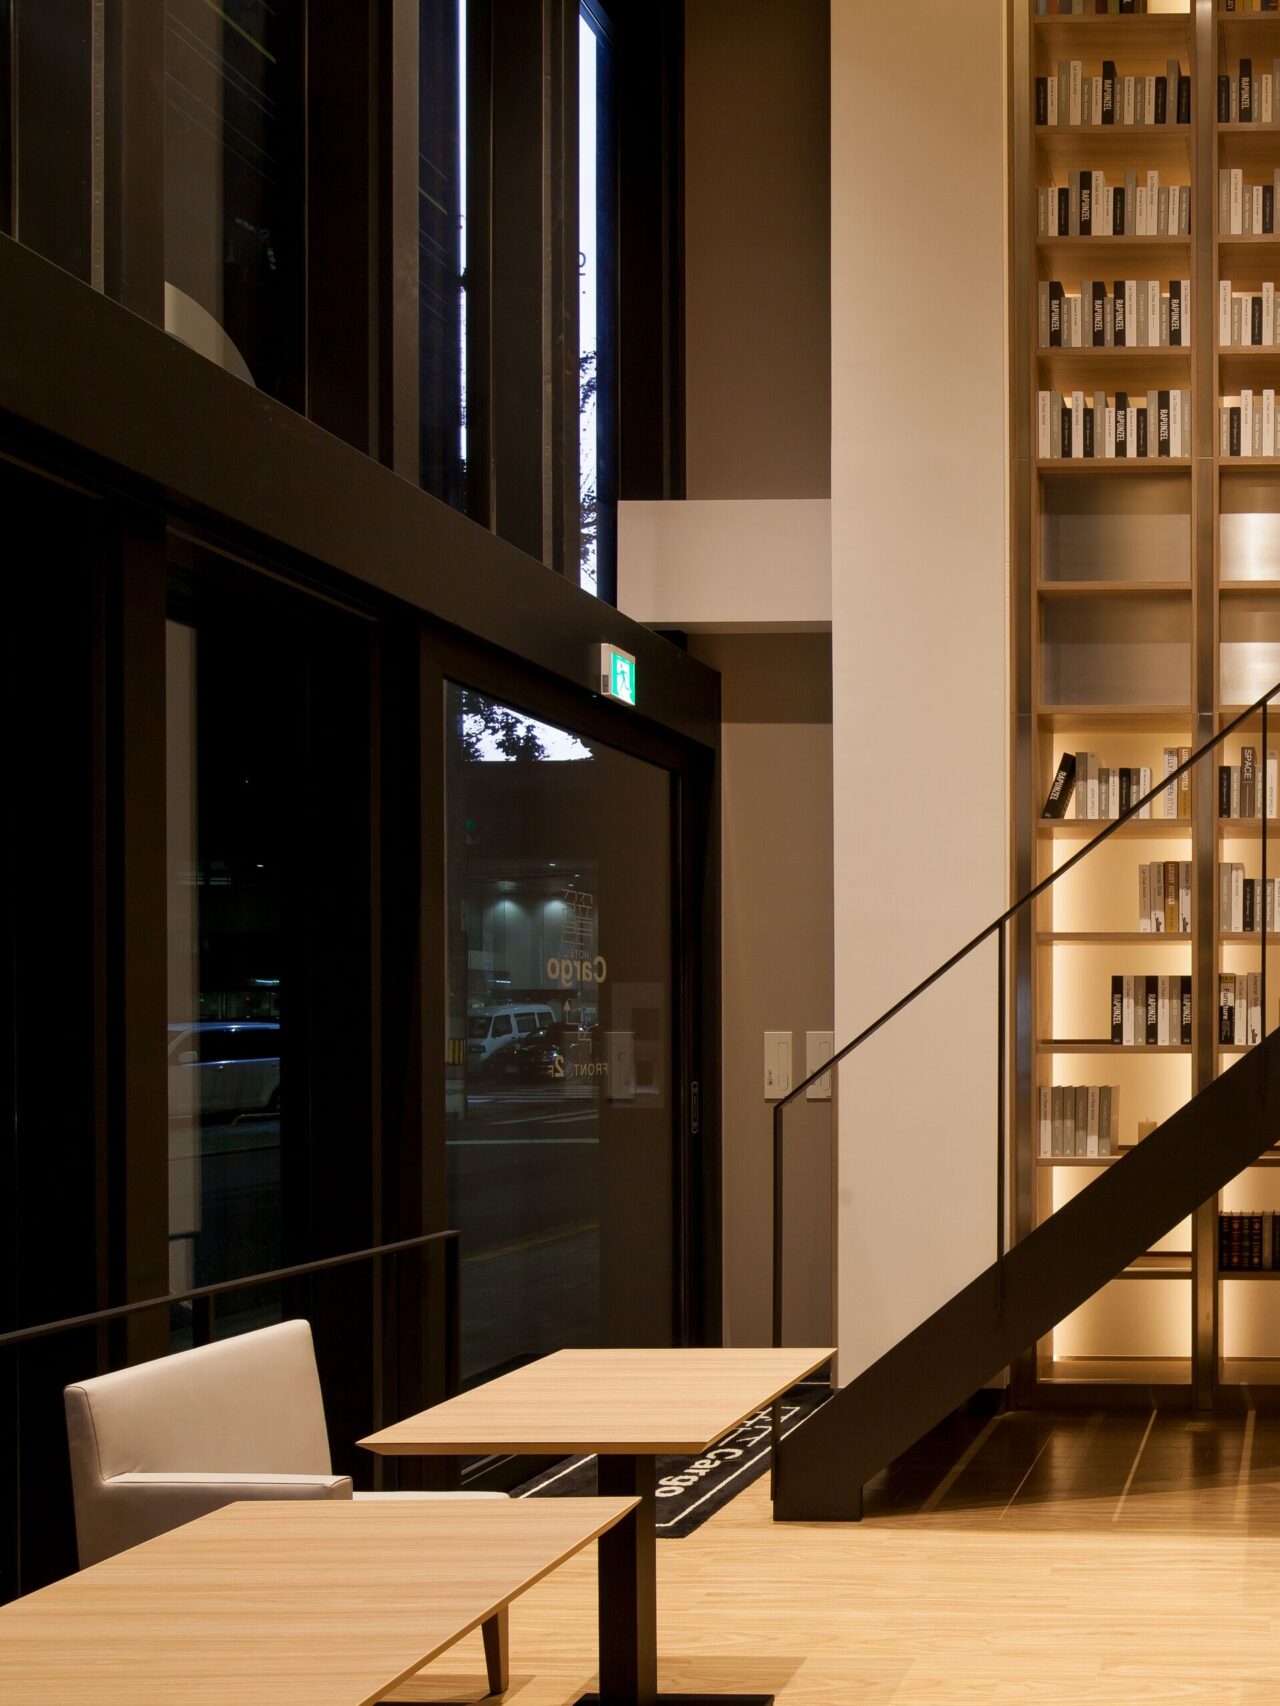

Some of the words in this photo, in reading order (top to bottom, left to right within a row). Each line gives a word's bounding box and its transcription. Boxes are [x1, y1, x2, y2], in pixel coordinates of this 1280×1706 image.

[1160, 410, 1168, 440] RAPUNZEL
[1244, 749, 1252, 779] SPACE
[1049, 771, 1067, 800] RAPUNZEL
[1113, 995, 1121, 1024] RAPUNZEL
[1148, 994, 1156, 1024] RAPUNZEL
[655, 1448, 744, 1498] Cargo
